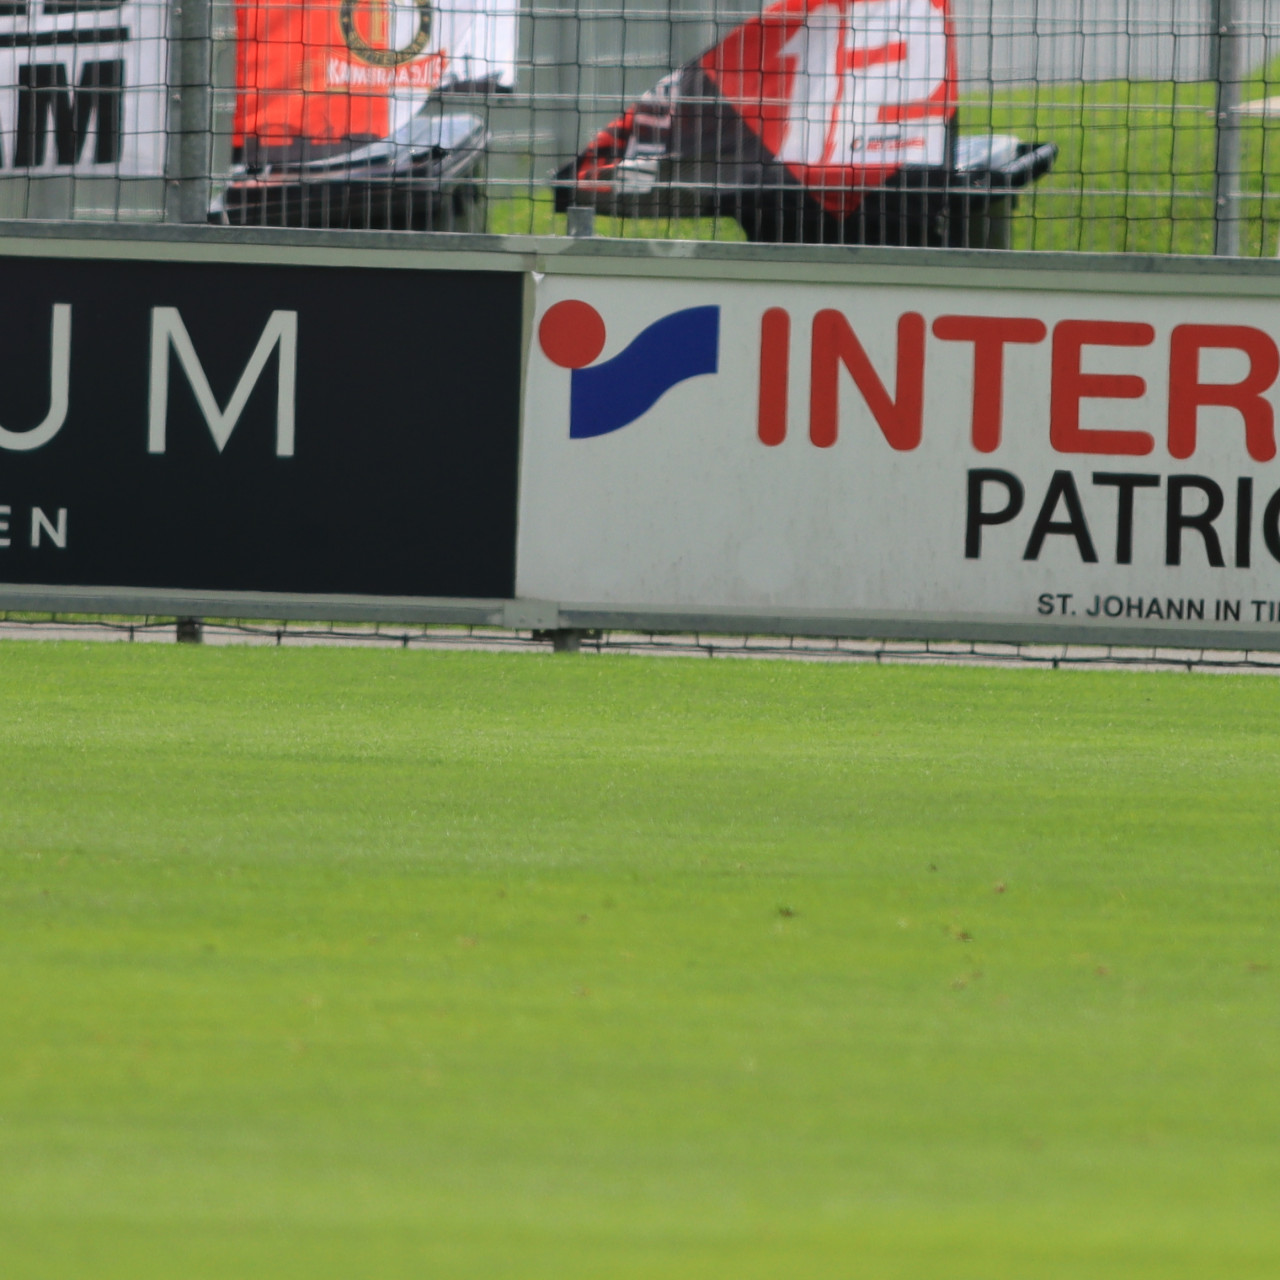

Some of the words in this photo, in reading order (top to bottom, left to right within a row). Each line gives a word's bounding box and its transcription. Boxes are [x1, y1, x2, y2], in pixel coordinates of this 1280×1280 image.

[1037, 593, 1076, 616] ST.
[1086, 595, 1205, 620] JOHANN
[1215, 599, 1241, 622] IN
